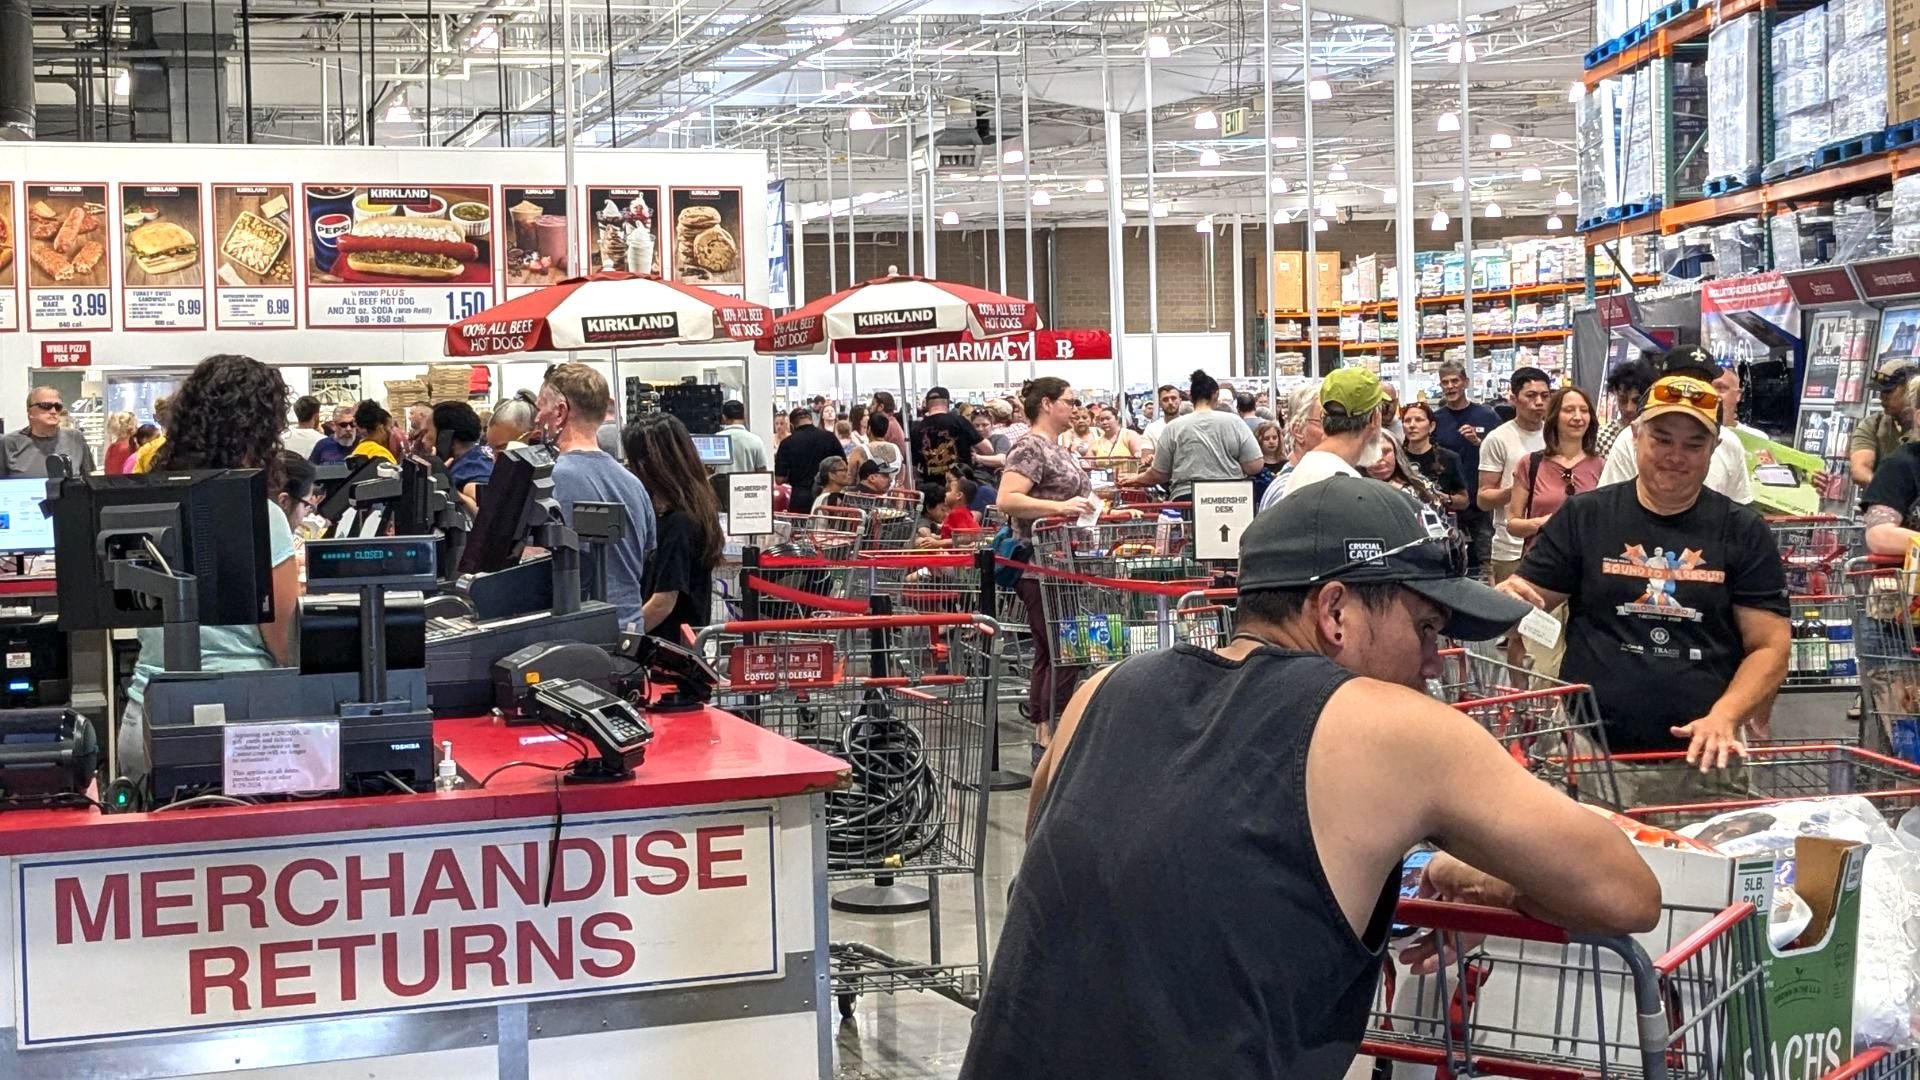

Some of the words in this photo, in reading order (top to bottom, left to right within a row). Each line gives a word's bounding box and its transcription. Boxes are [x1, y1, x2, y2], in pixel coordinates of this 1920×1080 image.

[1225, 110, 1240, 133] EXIT
[370, 188, 429, 199] KIRKLAND
[317, 223, 350, 235] PEPSI
[380, 289, 405, 297] PLUS
[72, 293, 107, 316] 3.99
[178, 299, 201, 315] 6.99
[267, 299, 289, 315] 6.99
[398, 297, 415, 305] DOG
[446, 292, 485, 320] 1.50
[328, 307, 345, 315] AND
[346, 307, 356, 315] 20
[371, 306, 393, 315] SODA
[737, 308, 749, 321] ALL
[749, 308, 764, 321] BEEF
[977, 303, 995, 316] 100%
[996, 303, 1010, 316] ALL
[1009, 303, 1026, 316] BEEF
[355, 315, 370, 323] 580
[586, 315, 675, 332] KIRKLAND
[785, 320, 799, 333] ALL
[800, 316, 816, 330] BEEF
[858, 309, 934, 327] KIRKLAND
[984, 317, 999, 329] HOT
[1000, 317, 1022, 329] DOGS
[463, 323, 486, 337] 100%
[487, 322, 507, 335] ALL
[509, 319, 534, 334] BEEF
[729, 324, 743, 337] HOT
[743, 323, 764, 337] DOGS
[470, 337, 490, 352] HOT
[492, 336, 525, 351] DOGS
[774, 335, 788, 348] HOT
[788, 331, 808, 346] DOGS
[46, 344, 68, 353] WHOLE
[69, 344, 87, 353] PIZZA
[1200, 496, 1248, 505] MEMBERSHIP
[1215, 505, 1234, 513] DESK
[1348, 542, 1381, 550] CRUCIAL
[354, 550, 384, 559] CLOSED
[1349, 550, 1383, 559] CATCH
[1602, 562, 1645, 579] SOUND
[744, 672, 775, 681] COSTCO
[55, 824, 748, 945] MERCHANDISE
[1744, 877, 1765, 891] 5LB.
[189, 912, 637, 1015] RETURNS
